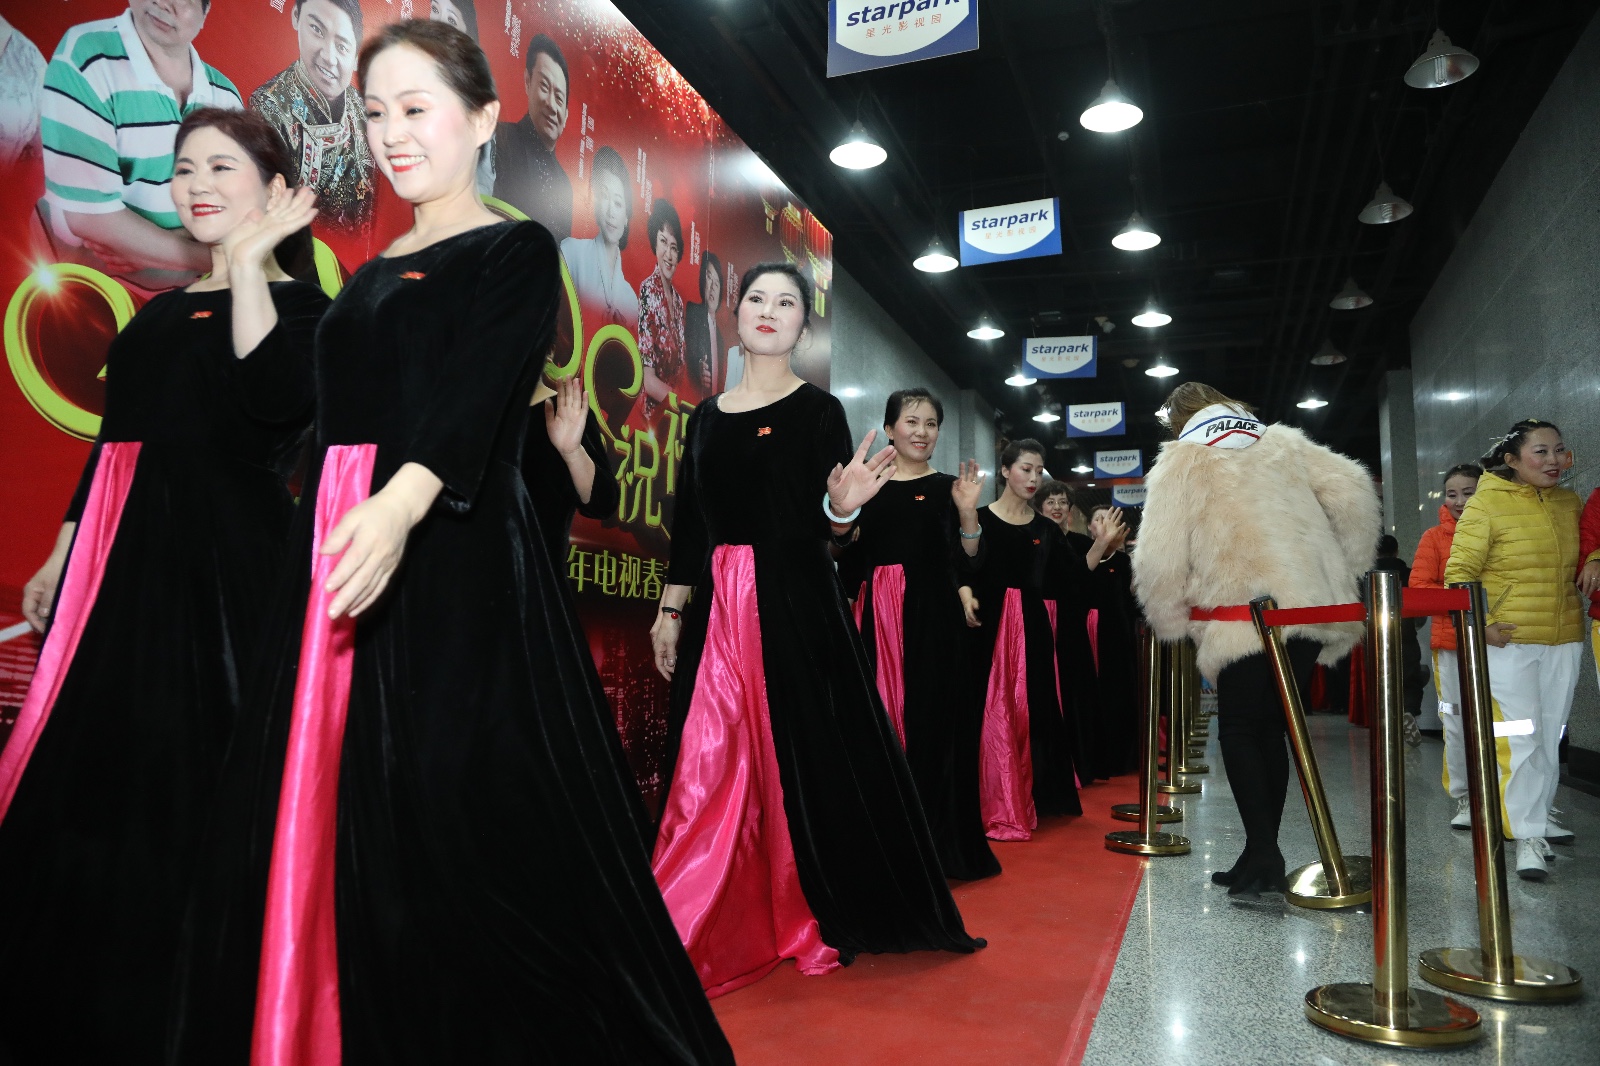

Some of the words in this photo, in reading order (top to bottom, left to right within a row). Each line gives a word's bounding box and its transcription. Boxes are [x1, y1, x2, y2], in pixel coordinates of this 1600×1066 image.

[846, 0, 960, 27] starpa
[865, 13, 942, 39] 星光影视园
[971, 208, 1049, 231] starpark
[1031, 343, 1089, 355] starpark
[1073, 408, 1119, 418] starpark
[1205, 419, 1258, 438] PALACE
[1100, 454, 1138, 463] starpark
[567, 544, 670, 600] 年电视春
